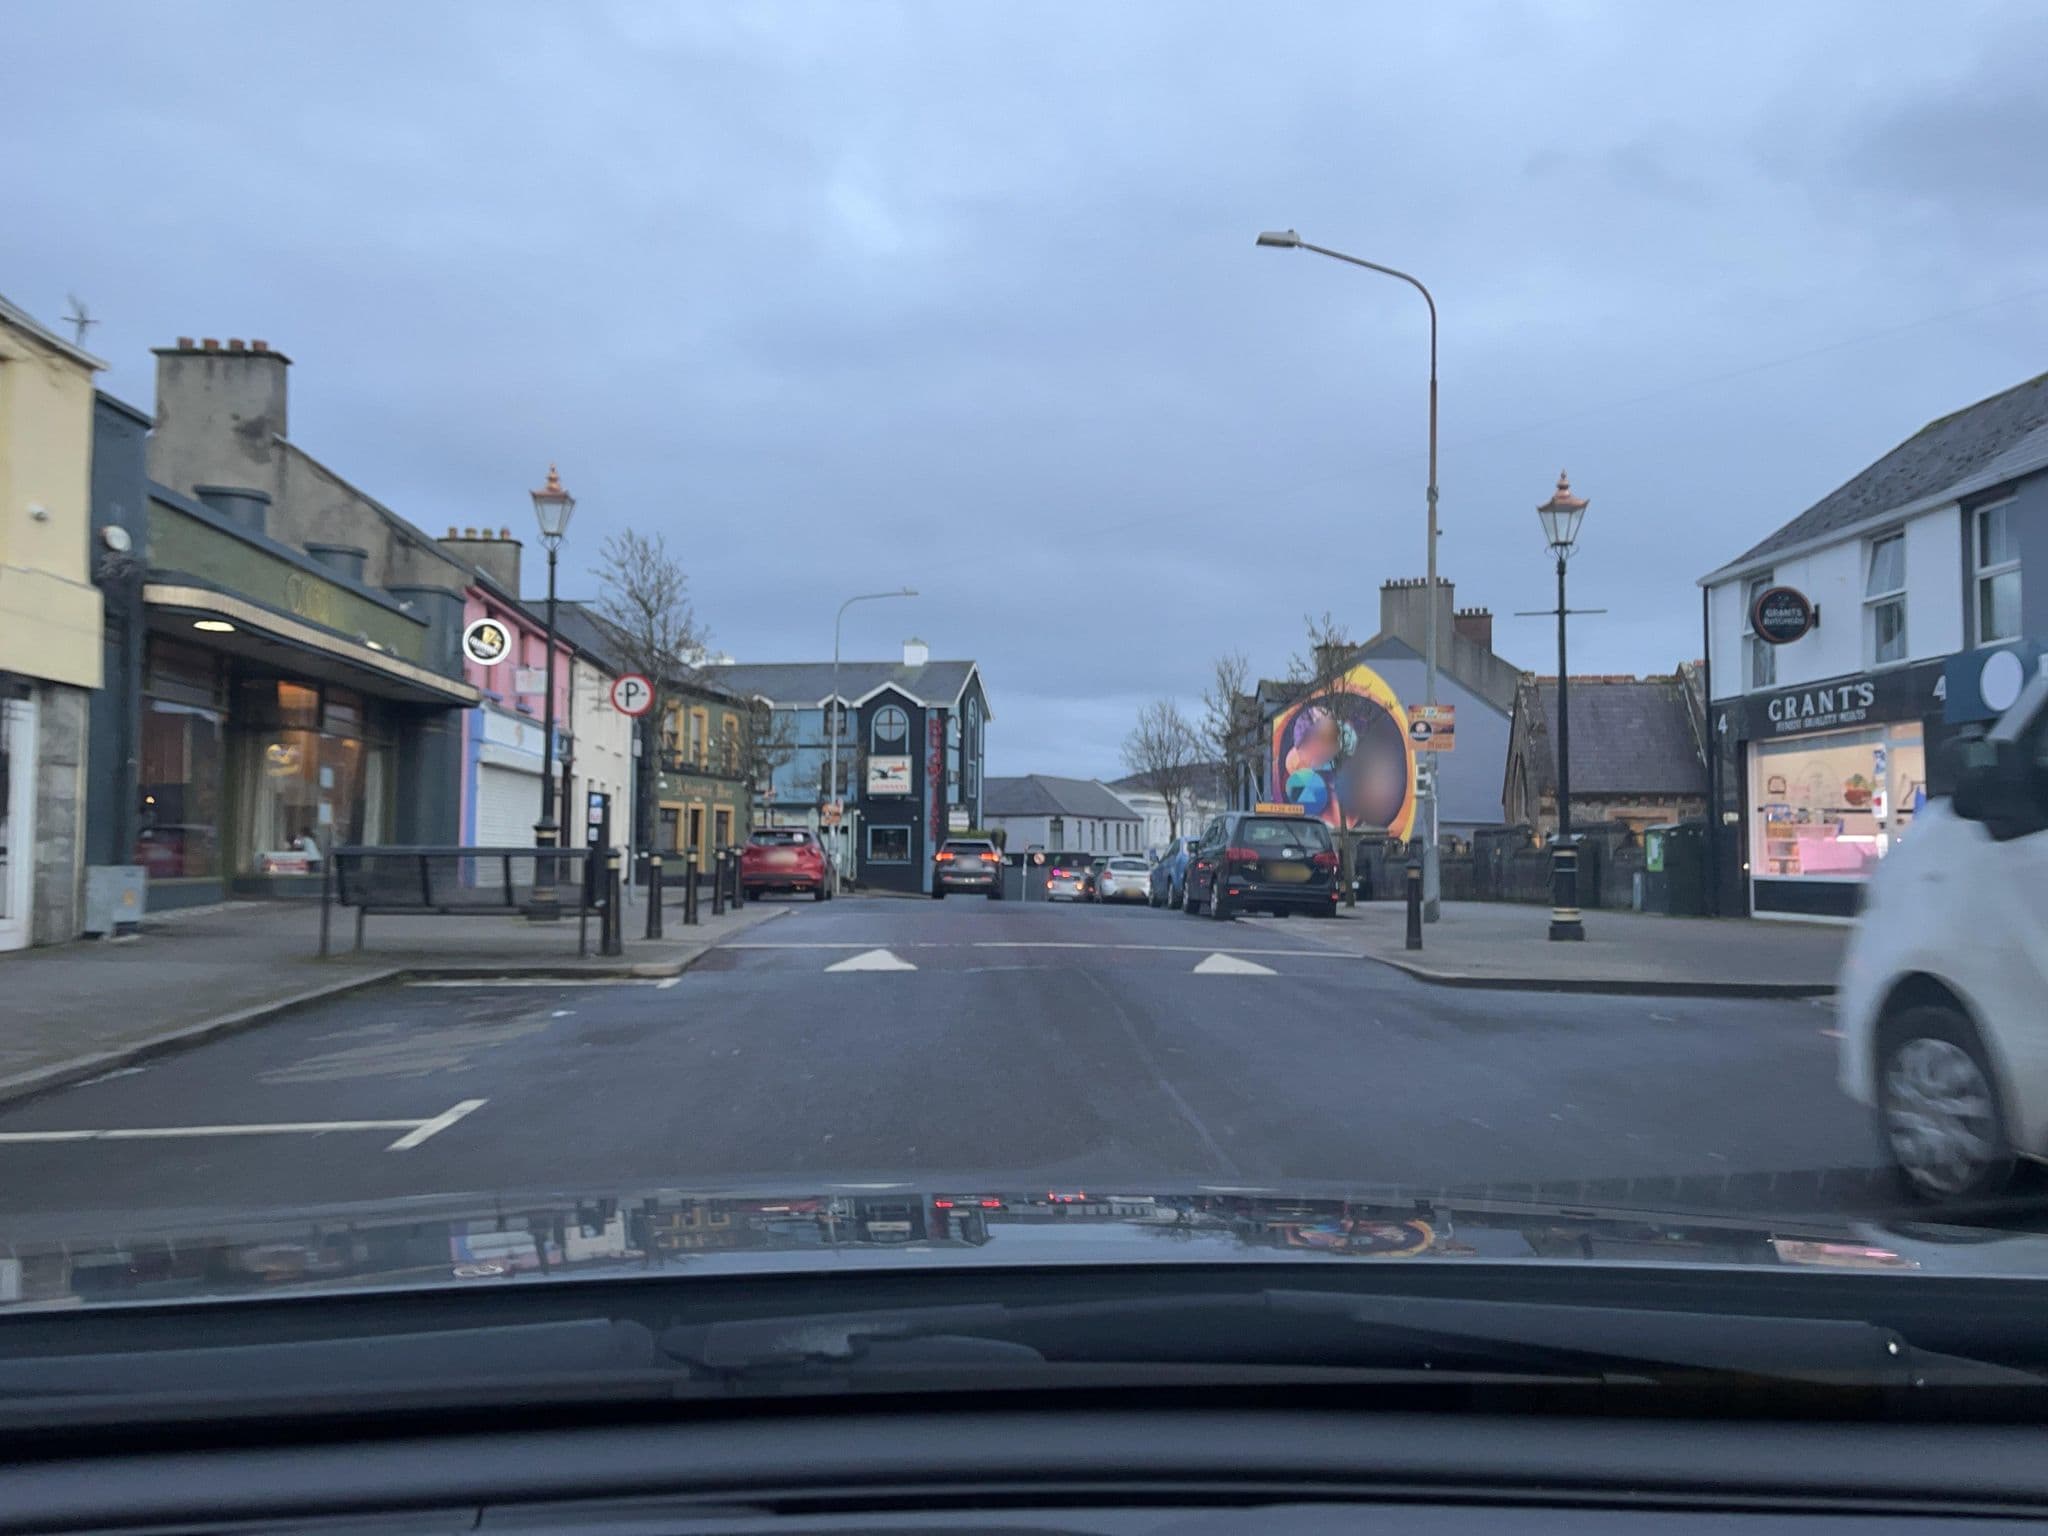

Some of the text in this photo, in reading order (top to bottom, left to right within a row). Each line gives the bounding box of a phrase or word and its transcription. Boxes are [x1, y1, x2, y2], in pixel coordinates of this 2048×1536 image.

[626, 681, 639, 707] P
[1932, 675, 1947, 701] 4
[1768, 682, 1875, 722] GRANT'S
[1717, 713, 1729, 735] 4
